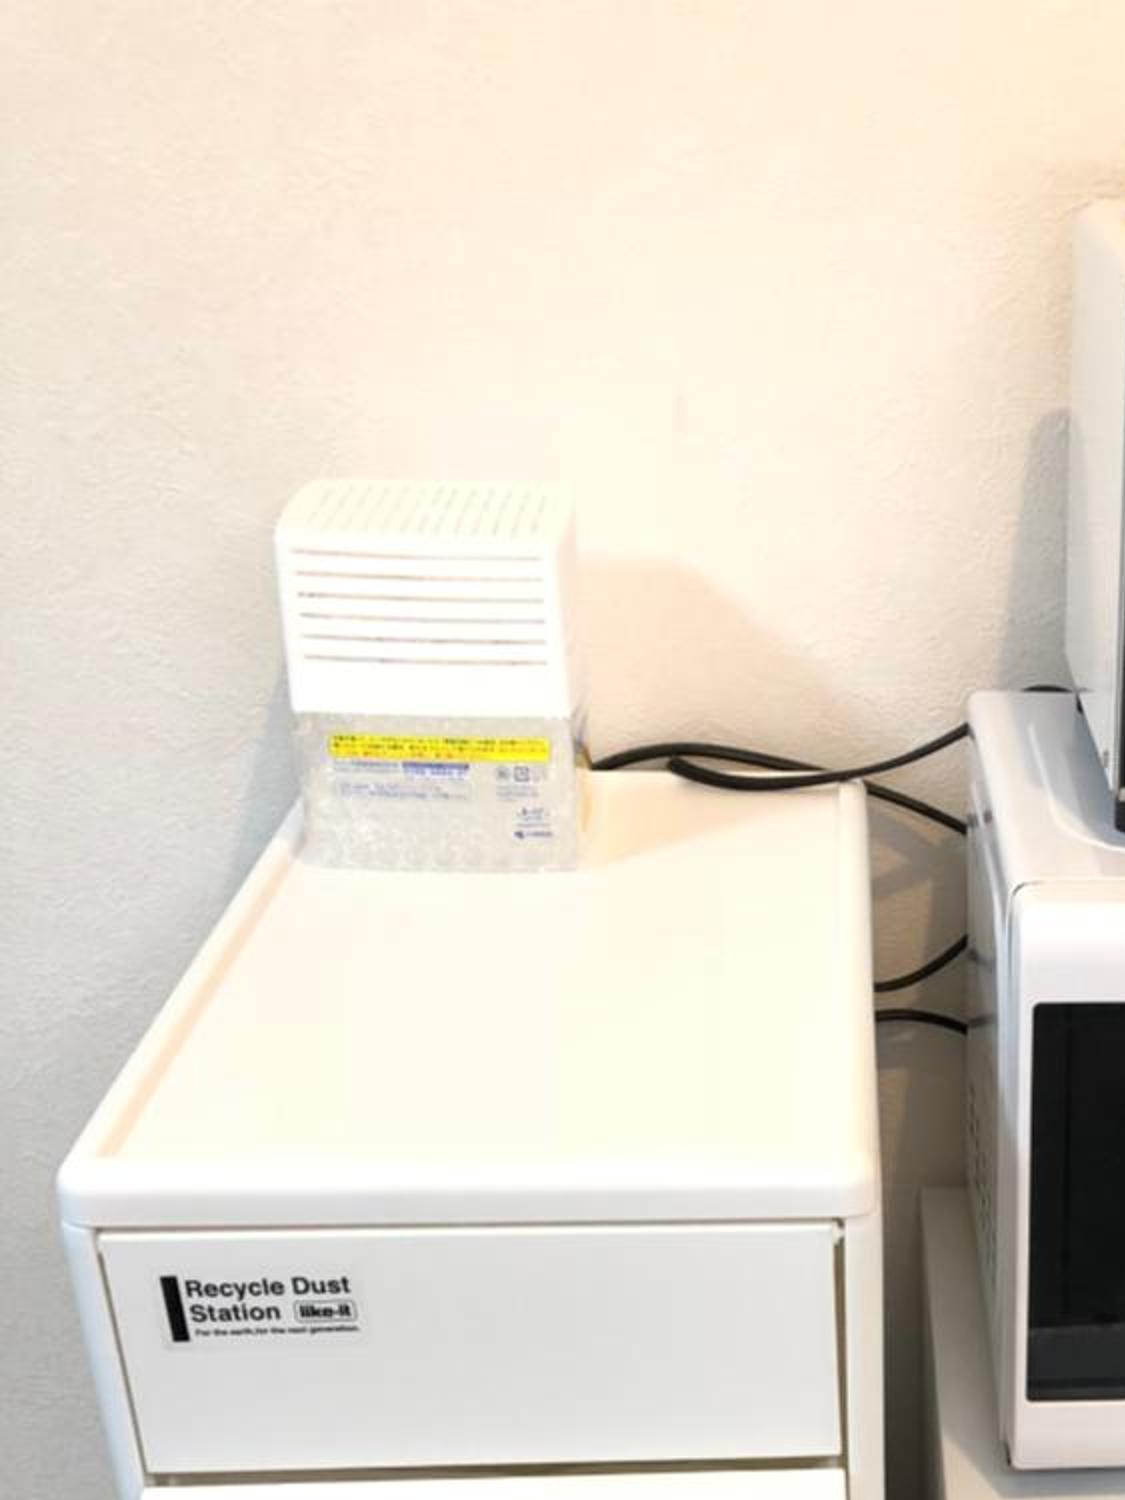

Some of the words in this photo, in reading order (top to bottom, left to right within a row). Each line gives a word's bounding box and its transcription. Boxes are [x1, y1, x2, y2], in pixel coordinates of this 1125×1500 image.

[184, 1278, 285, 1302] Recycle
[291, 1276, 351, 1296] Dust
[189, 1303, 281, 1323] Station
